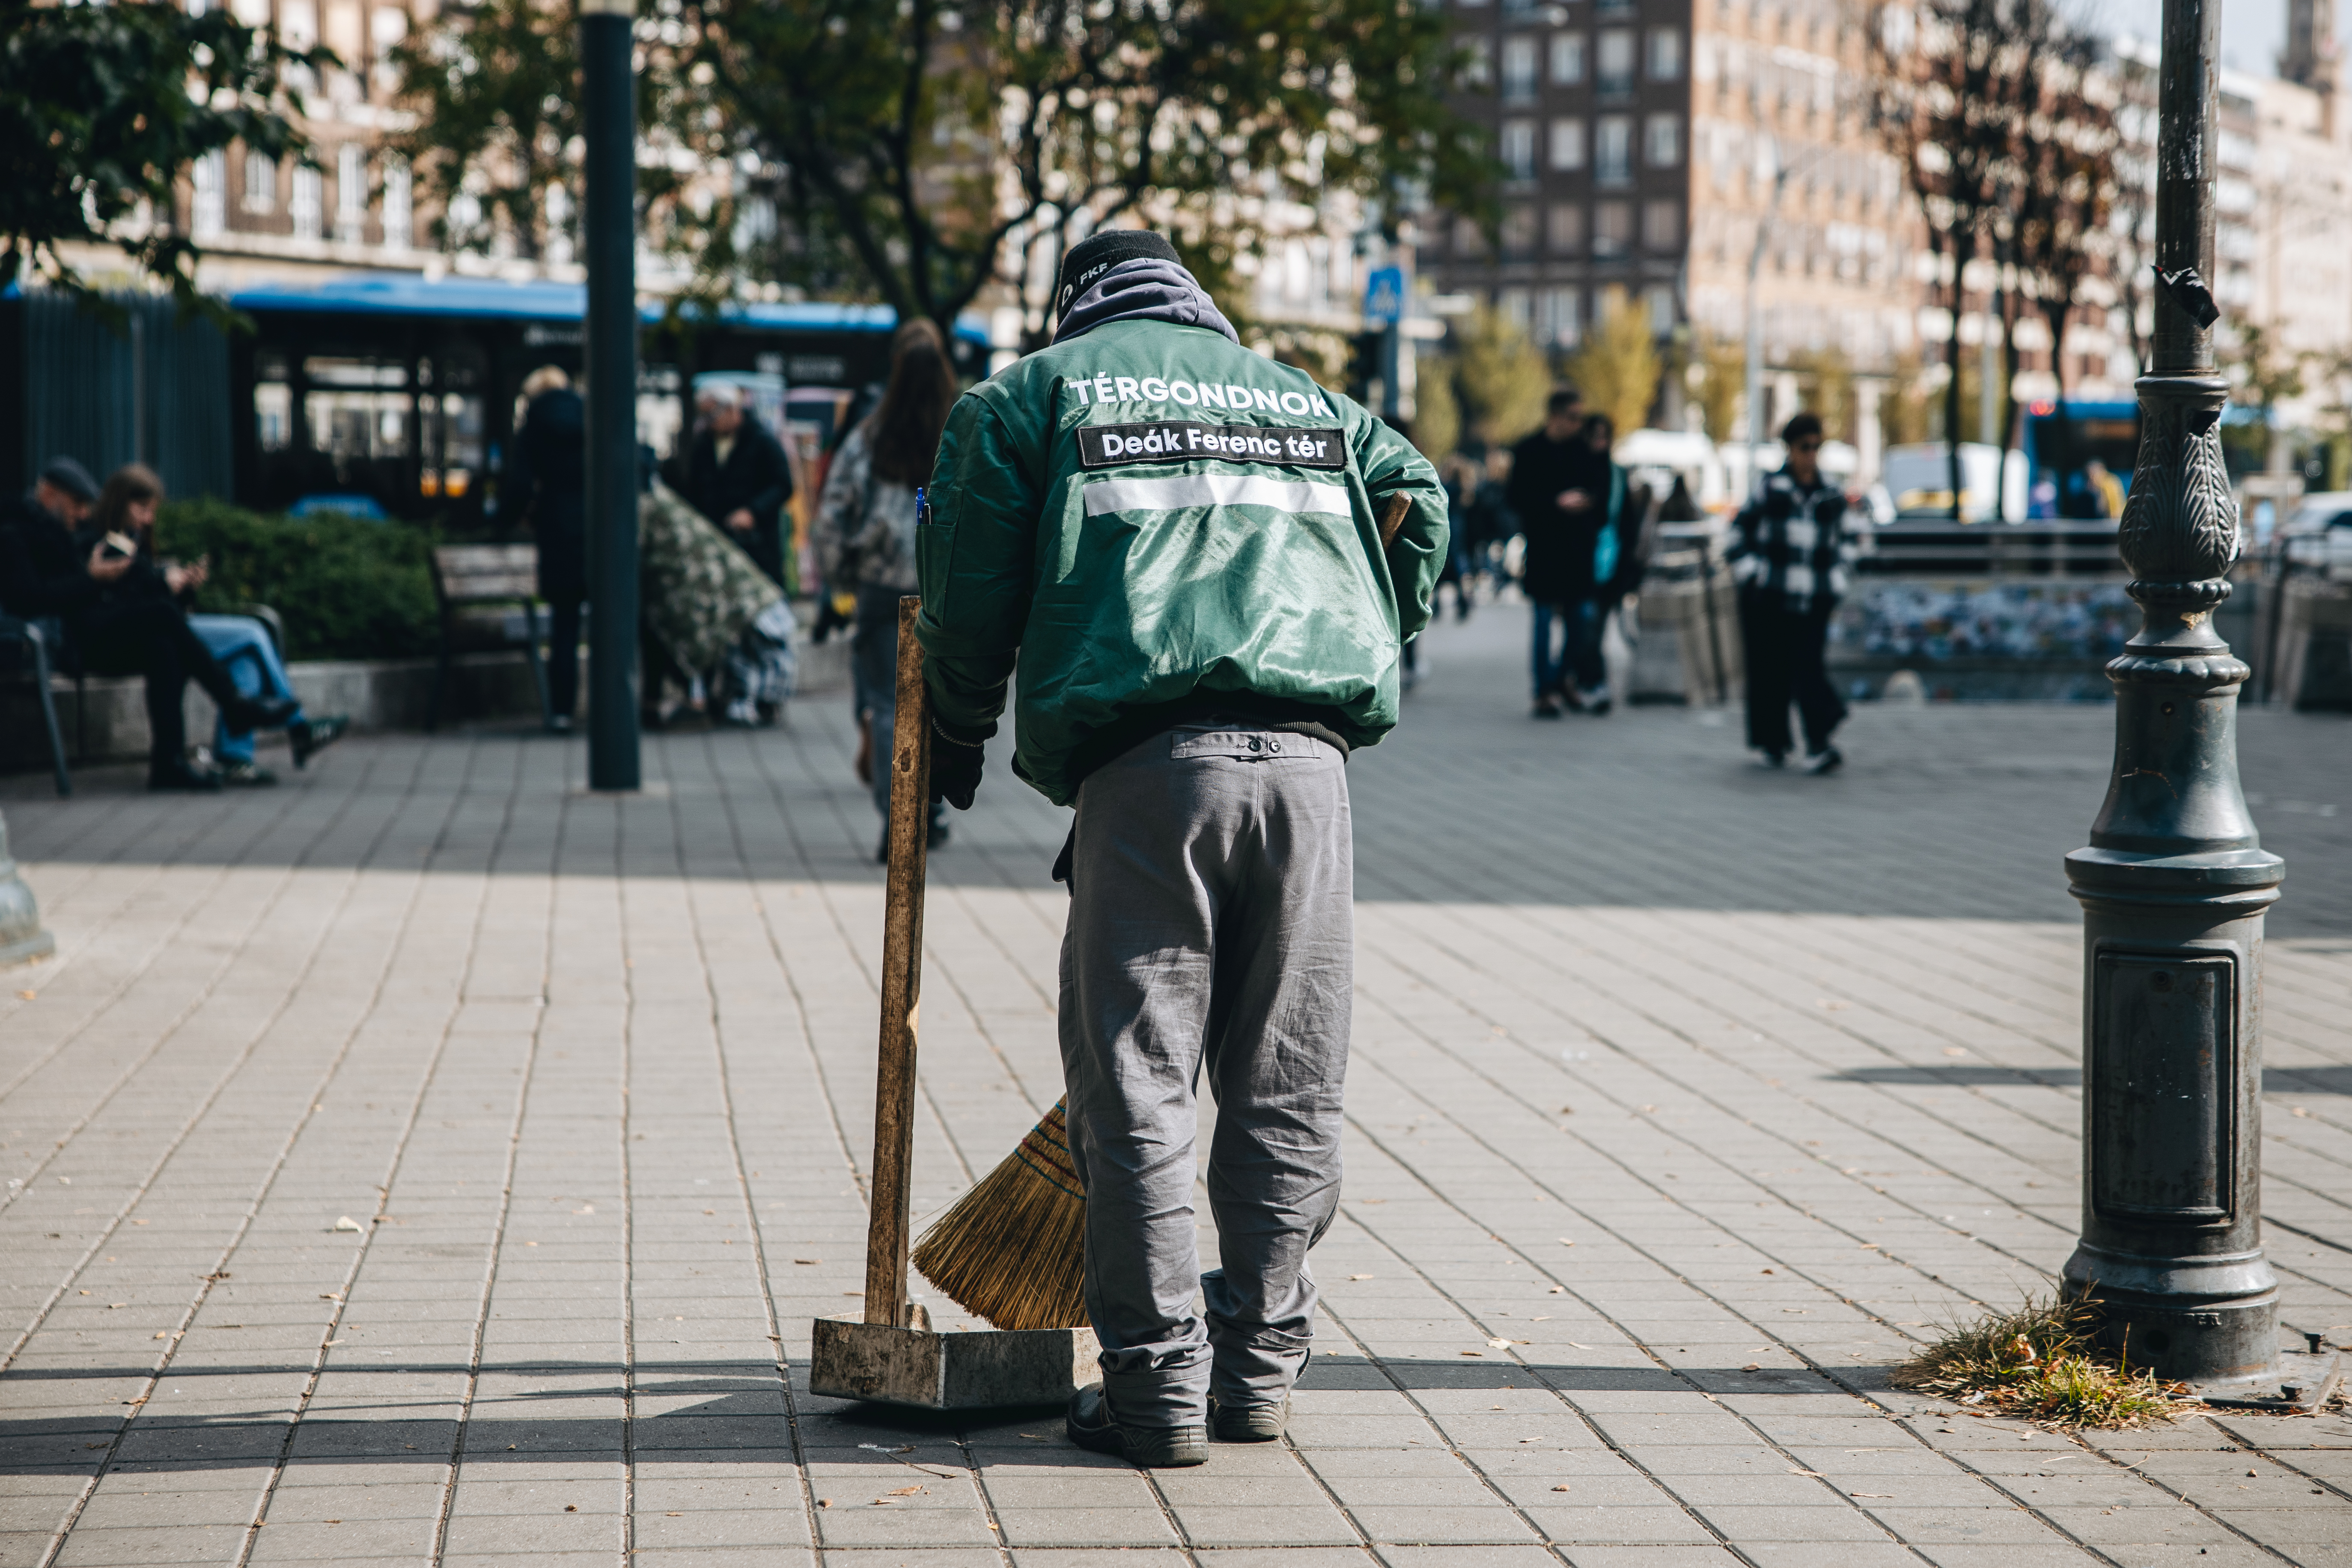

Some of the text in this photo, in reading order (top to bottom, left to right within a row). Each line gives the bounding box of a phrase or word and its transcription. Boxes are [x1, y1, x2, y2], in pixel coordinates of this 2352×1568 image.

[1080, 262, 1107, 285] FKF
[1069, 371, 1336, 418] TÉRGONDNOK
[1102, 428, 1327, 458] Deák Ferenc tér
